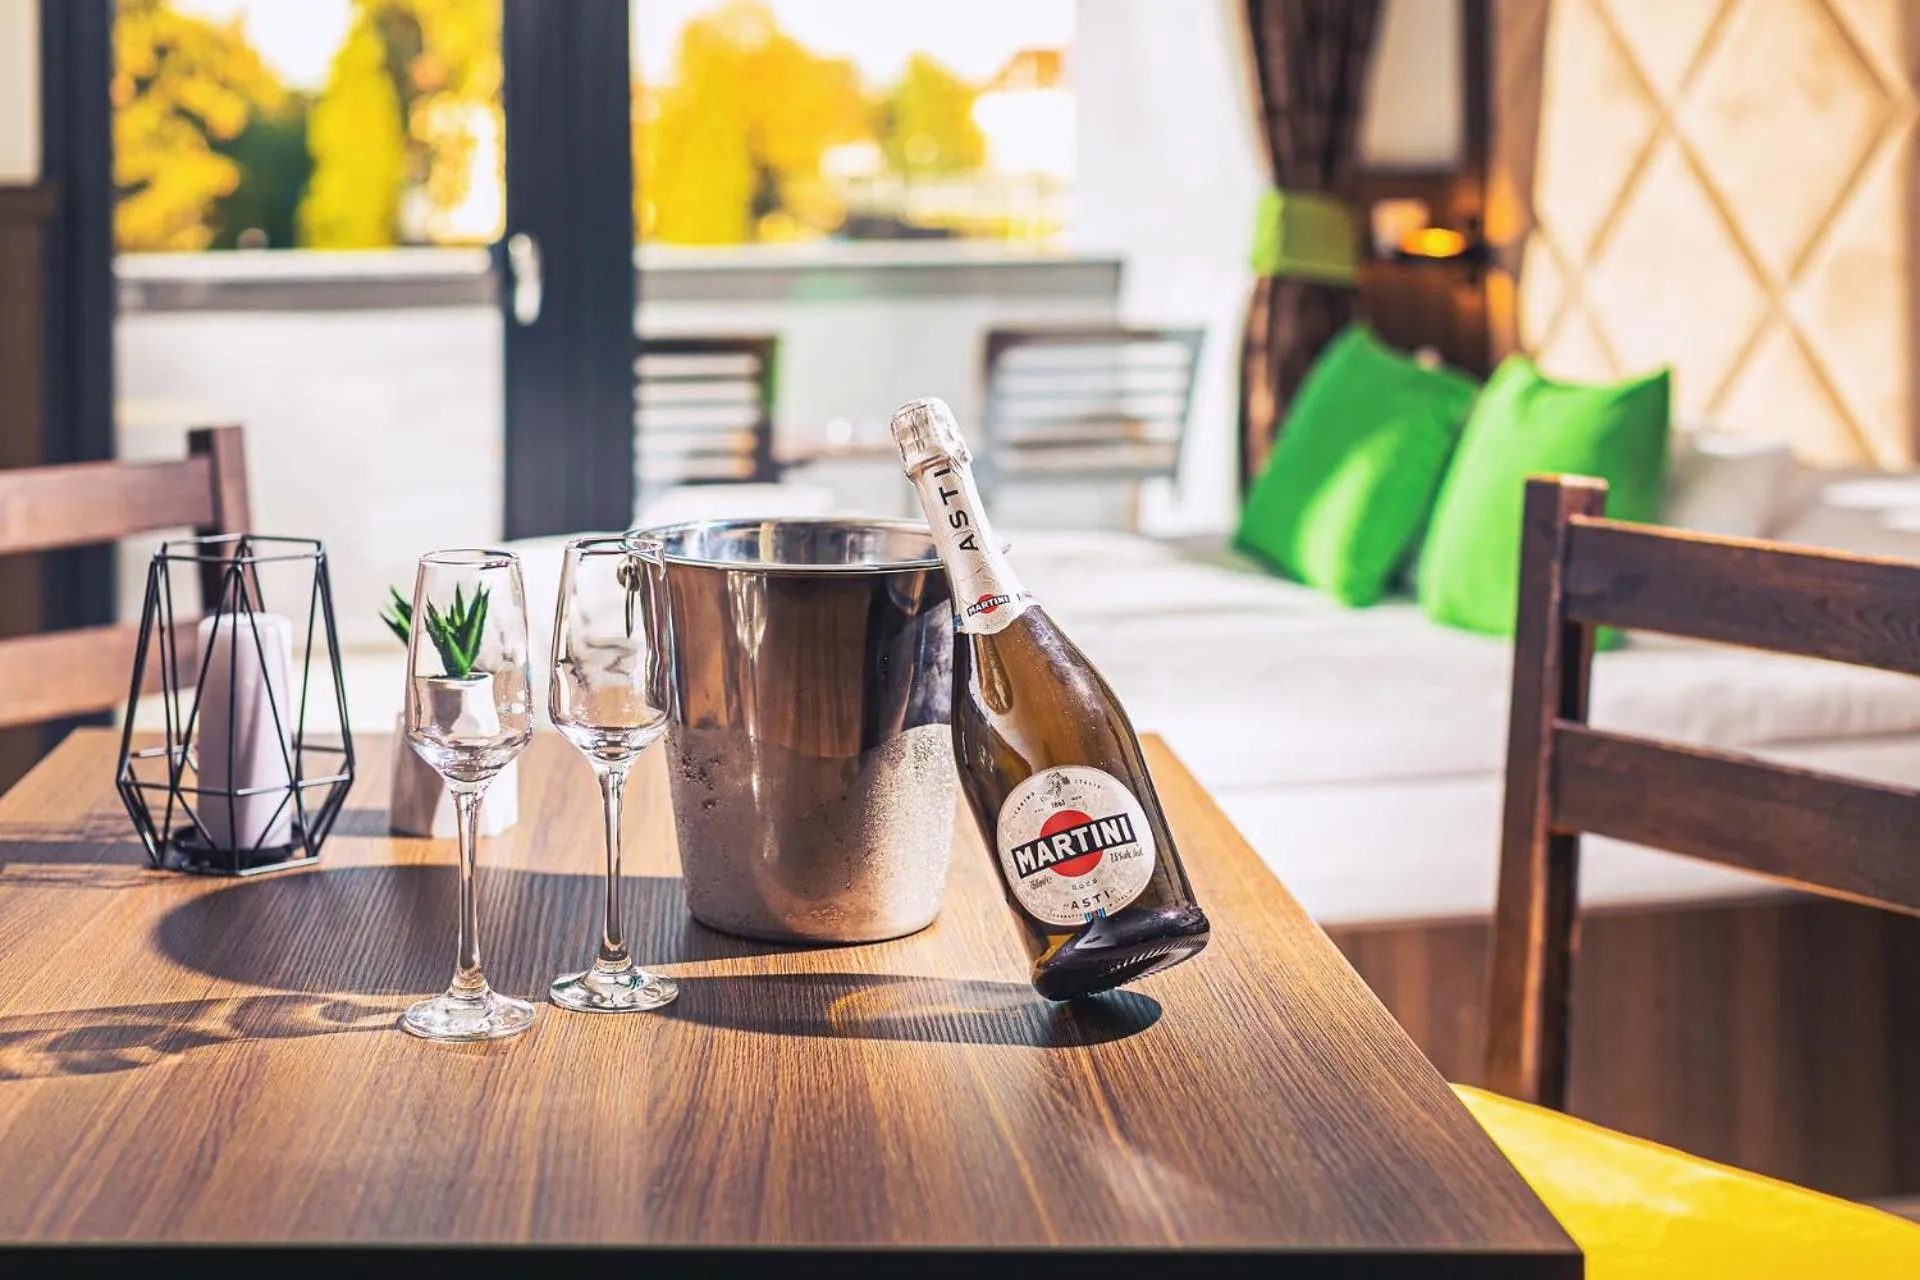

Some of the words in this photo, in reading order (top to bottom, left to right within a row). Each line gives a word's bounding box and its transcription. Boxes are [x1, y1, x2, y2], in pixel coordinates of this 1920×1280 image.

[933, 467, 979, 552] ASTI
[968, 594, 1009, 616] MARTINI
[1014, 816, 1133, 875] MARTINI
[1070, 890, 1111, 910] ASTI
